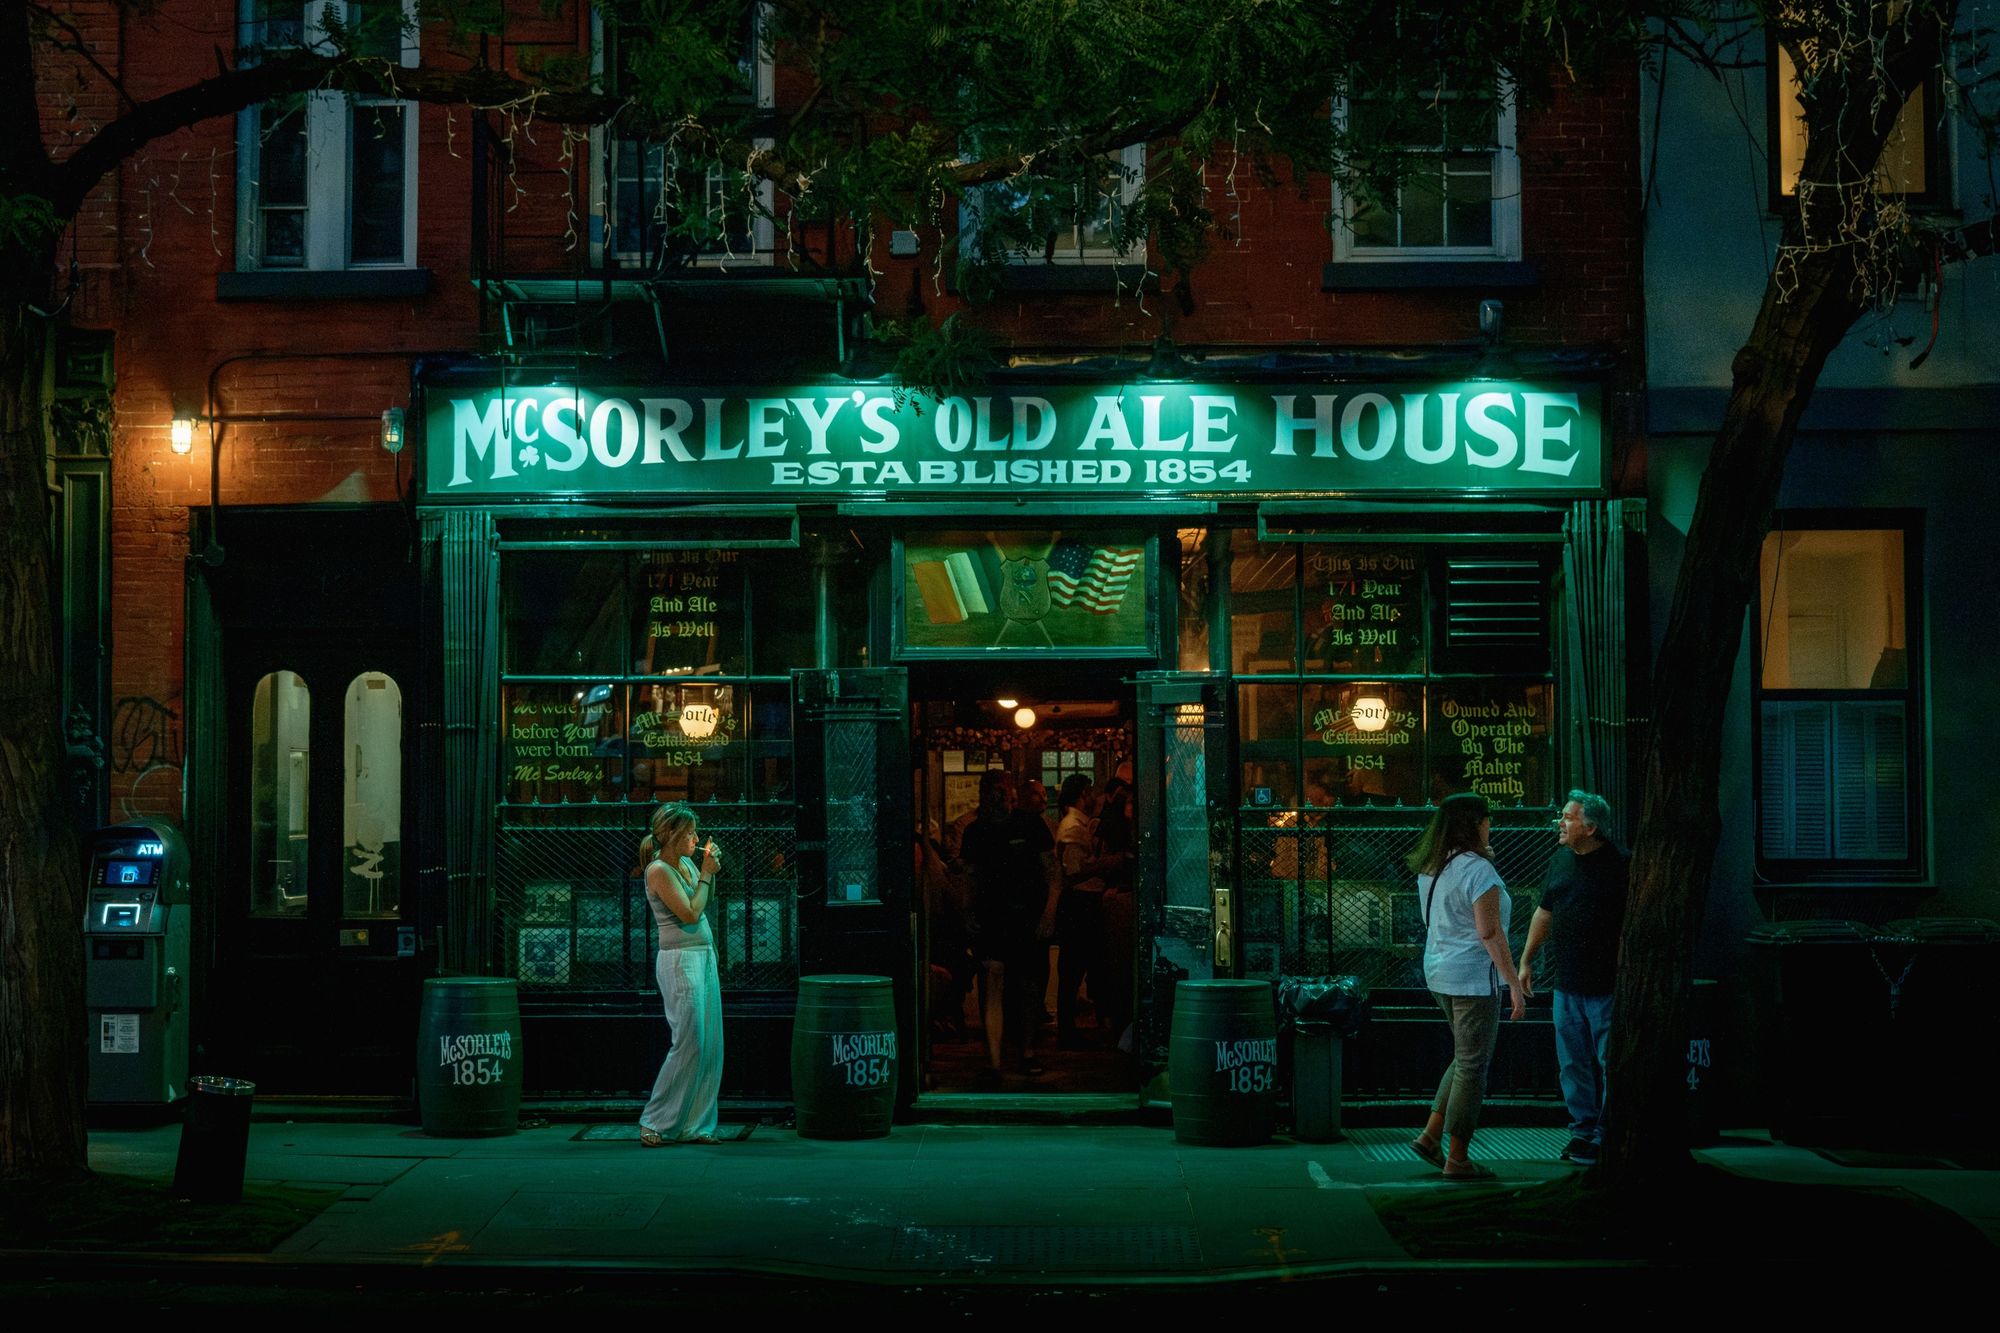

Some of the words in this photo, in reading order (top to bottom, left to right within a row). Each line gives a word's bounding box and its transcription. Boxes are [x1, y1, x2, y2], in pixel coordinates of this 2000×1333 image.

[934, 395, 1057, 452] OLD
[1076, 395, 1238, 454] ALE
[1270, 391, 1581, 477] HOUSE
[771, 461, 1132, 485] ESTABLISHED
[1143, 459, 1252, 484] 1854
[1313, 553, 1351, 575] This
[1356, 554, 1377, 571] Is
[1382, 553, 1416, 571] Our
[680, 570, 720, 592] Year
[1328, 580, 1357, 597] 171
[1361, 579, 1402, 598] Year
[649, 595, 684, 613] And
[687, 595, 718, 613] Ale
[1331, 603, 1366, 621] And
[1370, 603, 1399, 621] Ale
[649, 620, 672, 638] Is
[676, 620, 716, 638] Well
[1331, 628, 1354, 646] Is
[1357, 628, 1398, 646] Well
[541, 702, 578, 715] were
[1347, 704, 1419, 729] Sorley's
[1442, 700, 1500, 718] Owned
[1503, 702, 1536, 718] And
[512, 722, 560, 740] before
[562, 722, 598, 744] You
[1322, 729, 1410, 748] Established
[1451, 718, 1532, 741] Operated
[515, 744, 552, 757] were
[555, 740, 593, 757] born.
[665, 751, 703, 767] 1854
[1461, 737, 1485, 760] By
[1492, 737, 1526, 755] The
[514, 764, 541, 781] Mc
[544, 763, 605, 784] Sorley's
[1346, 755, 1386, 771] 1854
[1462, 758, 1522, 779] Maher
[1470, 776, 1525, 799] Family
[137, 843, 163, 856] ATM
[452, 1058, 504, 1086] 1854
[845, 1058, 890, 1086] 1854
[1230, 1064, 1273, 1094] 1854
